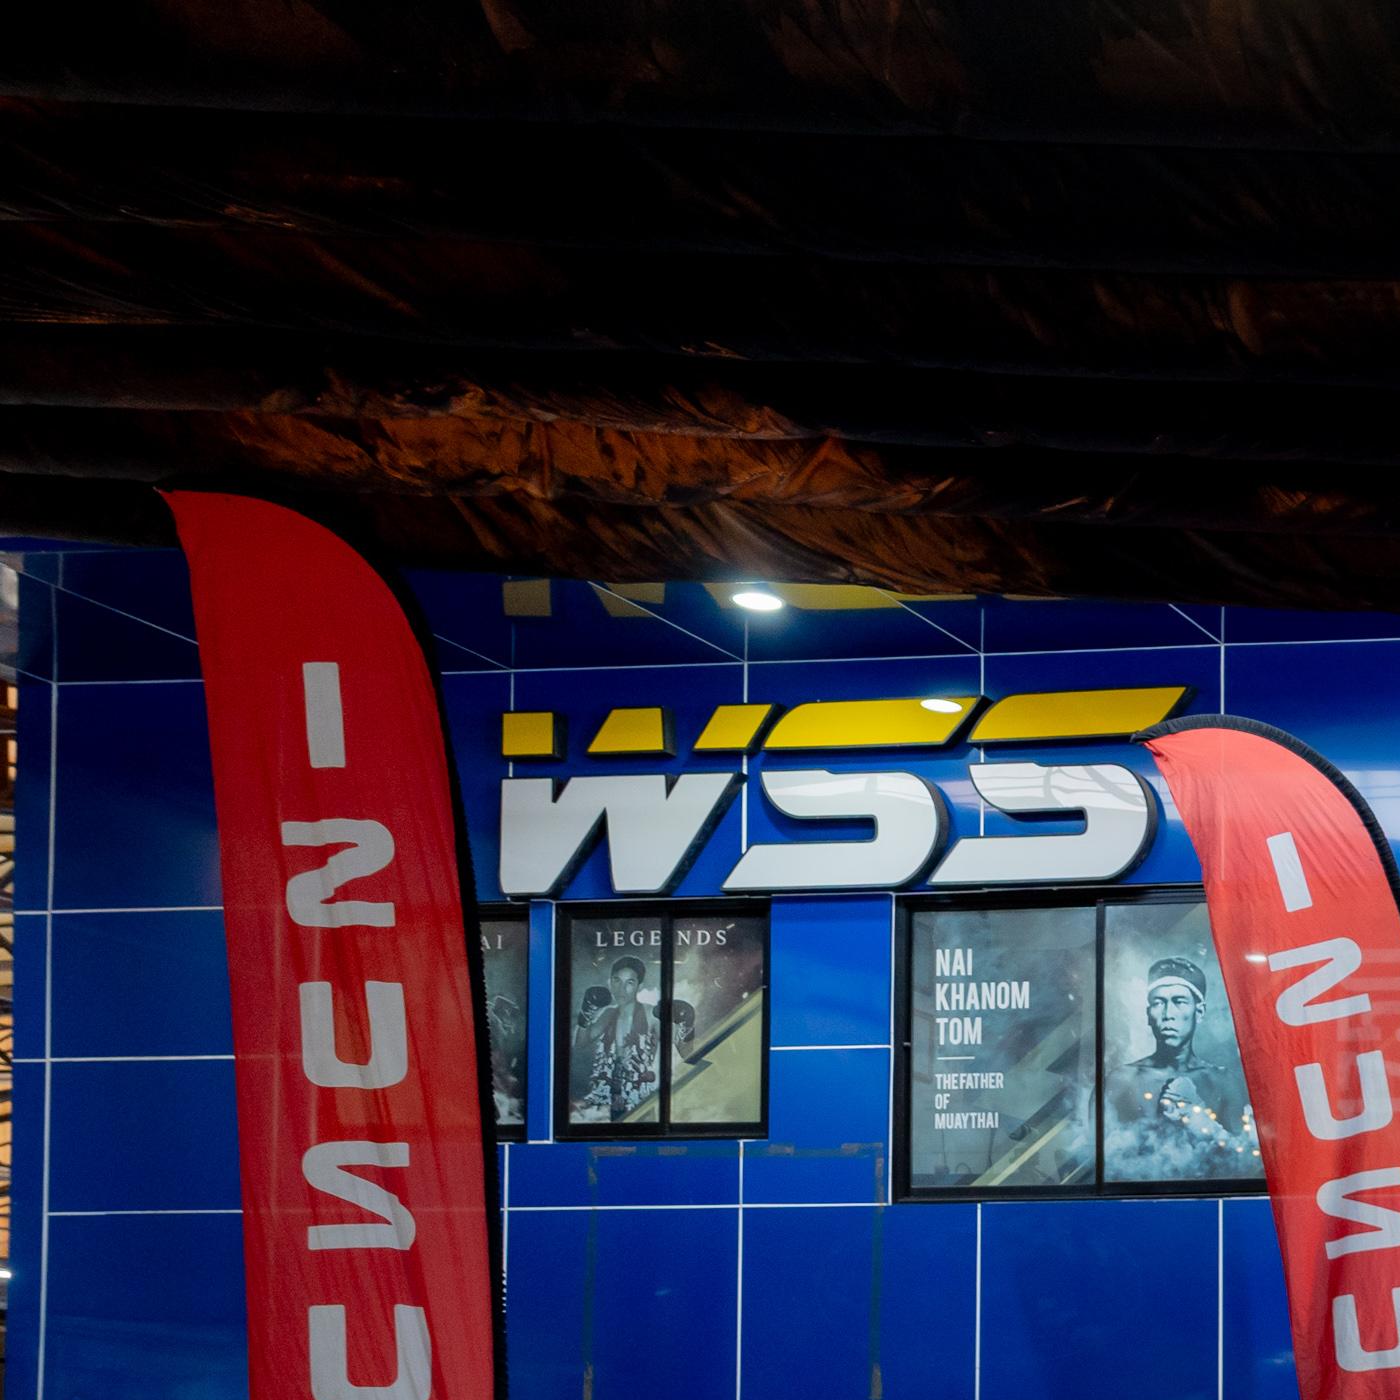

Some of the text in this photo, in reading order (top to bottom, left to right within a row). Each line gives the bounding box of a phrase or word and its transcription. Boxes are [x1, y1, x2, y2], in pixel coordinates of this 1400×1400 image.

[500, 686, 1191, 894] WSS
[596, 929, 728, 948] LEGENDS
[936, 949, 972, 976] NAI
[936, 981, 1029, 1010] KHANOM
[936, 1017, 982, 1045] TOM
[935, 1094, 950, 1109] OF
